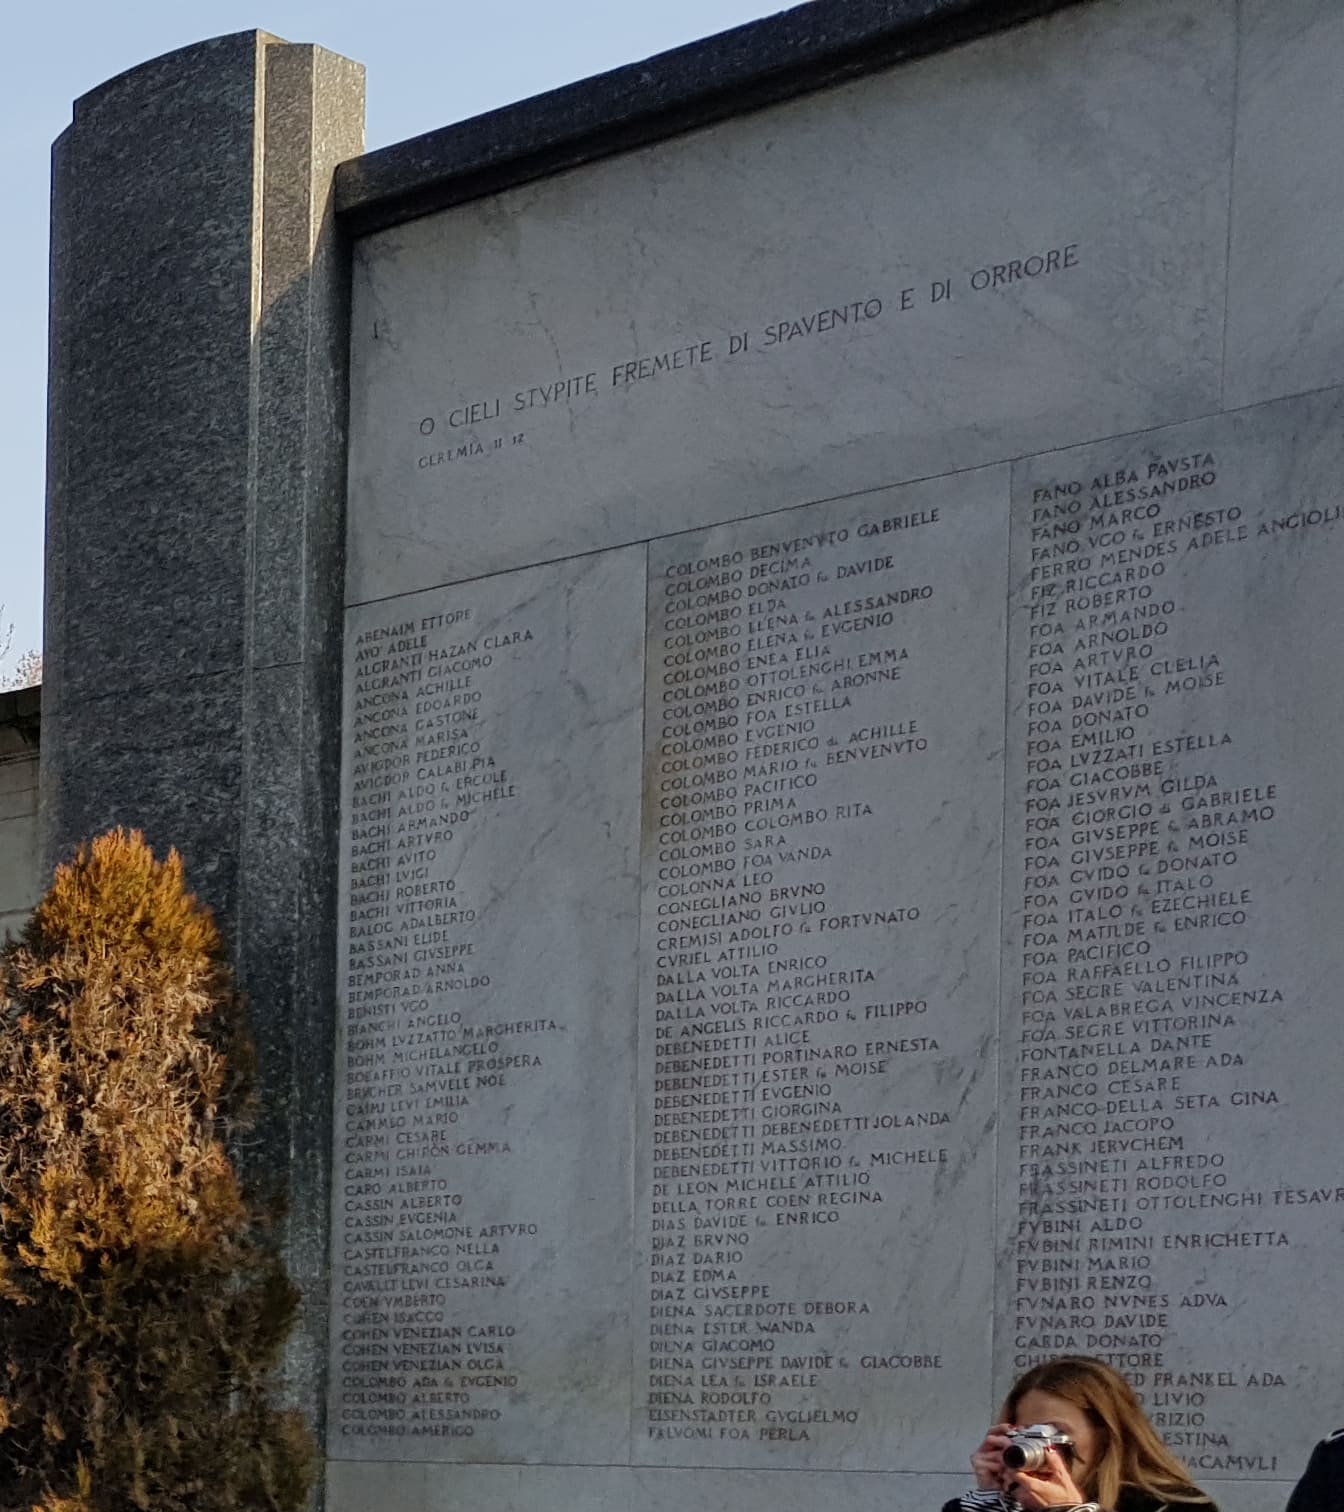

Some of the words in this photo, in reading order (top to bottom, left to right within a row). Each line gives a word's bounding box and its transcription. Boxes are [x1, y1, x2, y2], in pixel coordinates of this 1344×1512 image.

[419, 416, 435, 435] O
[449, 399, 500, 428] CIELI
[611, 341, 713, 386] FREMETE
[729, 332, 749, 355] DI
[764, 298, 883, 346] SPAVENTO
[900, 288, 915, 311] E
[931, 279, 952, 303] DI
[971, 244, 1080, 291] ORRORE
[1031, 499, 1083, 523] FANO
[1089, 470, 1218, 511] ALESSANDRO
[1030, 518, 1082, 542] FANO
[1090, 501, 1162, 530] MARCO
[662, 549, 745, 580] COLOMBO
[855, 507, 942, 539] GABRIELE
[1030, 555, 1092, 581] FERRO
[1100, 538, 1179, 568] MENDES
[1185, 524, 1250, 551] ADELE
[664, 568, 744, 598] COLOMBO
[664, 586, 744, 615] COLOMBO
[746, 572, 812, 598] DONATO
[835, 555, 896, 580] DAVIDE
[1064, 582, 1154, 613] ROBERTO
[1029, 619, 1065, 639] FOA
[1075, 599, 1177, 631] ARMANDO
[1027, 639, 1065, 659] FOA
[1074, 620, 1170, 651] ARNOLDO
[661, 676, 741, 704] COLOMBO
[746, 656, 852, 688] OTTOLENGHI
[857, 645, 911, 668] EMMA
[662, 659, 741, 687] COLOMBO
[794, 642, 832, 662] ELIA
[1027, 678, 1065, 698] FOA
[1073, 665, 1140, 690] VITALE
[1149, 651, 1222, 678] CLELIA
[661, 713, 740, 740] COLOMBO
[746, 707, 778, 725] FOA
[784, 694, 853, 719] ESTELLA
[1026, 716, 1063, 736] FOA
[1071, 702, 1151, 729] DONATO
[1026, 737, 1063, 756] FOA
[1070, 725, 1136, 749] EMILIO
[1025, 775, 1062, 794] FOA
[658, 803, 738, 828] COLOMBO
[743, 794, 798, 815] PRIMA
[658, 822, 738, 846] COLOMBO
[743, 808, 829, 834] COLOMBO
[834, 802, 875, 821] RITA
[657, 857, 737, 881] COLOMBO
[742, 852, 774, 869] FOA
[777, 844, 834, 865] VANDA
[658, 839, 737, 863] COLOMBO
[744, 832, 788, 851] SARA
[657, 876, 736, 899] COLONNA
[742, 871, 774, 888] LEO
[655, 968, 707, 987] DALLA
[710, 963, 761, 981] VOLTA
[767, 955, 829, 975] ENRICO
[1021, 969, 1058, 987] FOA
[1067, 958, 1172, 983] RAFFAELLO
[1179, 950, 1251, 972] FILIPPO
[655, 987, 706, 1005] DALLA
[711, 981, 760, 1000] VOLTA
[766, 969, 877, 994] MARGHERITA
[654, 1004, 706, 1022] DALLA
[710, 999, 759, 1017] VOLTA
[766, 990, 852, 1012] RICCARDO
[654, 1034, 757, 1057] DEBENEDETTI
[764, 1030, 810, 1047] ALICE
[654, 1052, 757, 1074] DEBENEDETTI
[762, 1044, 859, 1065] PORTINARO
[864, 1037, 941, 1057] ERNESTA
[1020, 1039, 1142, 1063] FONTANELLA
[1150, 1033, 1213, 1053] DANTE
[1020, 1062, 1099, 1082] FRANCO
[1205, 1051, 1245, 1069] ADA
[1019, 1081, 1099, 1101] FRANCO
[1107, 1075, 1182, 1095] CESARE
[653, 1106, 756, 1126] DEBENEDETTI
[761, 1100, 843, 1119] GIORGINA
[652, 1142, 756, 1162] DEBENEDETTI
[761, 1137, 843, 1155] MASSIMO
[1136, 1152, 1226, 1172] ALFREDO
[725, 1176, 797, 1193] MICHELE
[803, 1172, 872, 1189] ATTILIO
[1135, 1172, 1229, 1191] RODOLFO
[651, 1199, 699, 1214] DELLA
[706, 1196, 758, 1212] TORRE
[817, 1190, 886, 1207] REGINA
[1088, 1235, 1155, 1252] RIMINI
[1162, 1230, 1291, 1249] ENRICHETTA
[650, 1252, 686, 1266] DIAZ
[693, 1250, 744, 1265] DARIO
[649, 1269, 686, 1284] DIAZ
[649, 1322, 696, 1336] DIENA
[702, 1321, 748, 1335] ESTER
[755, 1320, 817, 1335] WANDA
[1153, 1371, 1240, 1386] FRANKEL
[1245, 1371, 1288, 1386] ADA
[1153, 1391, 1207, 1406] LIVIO
